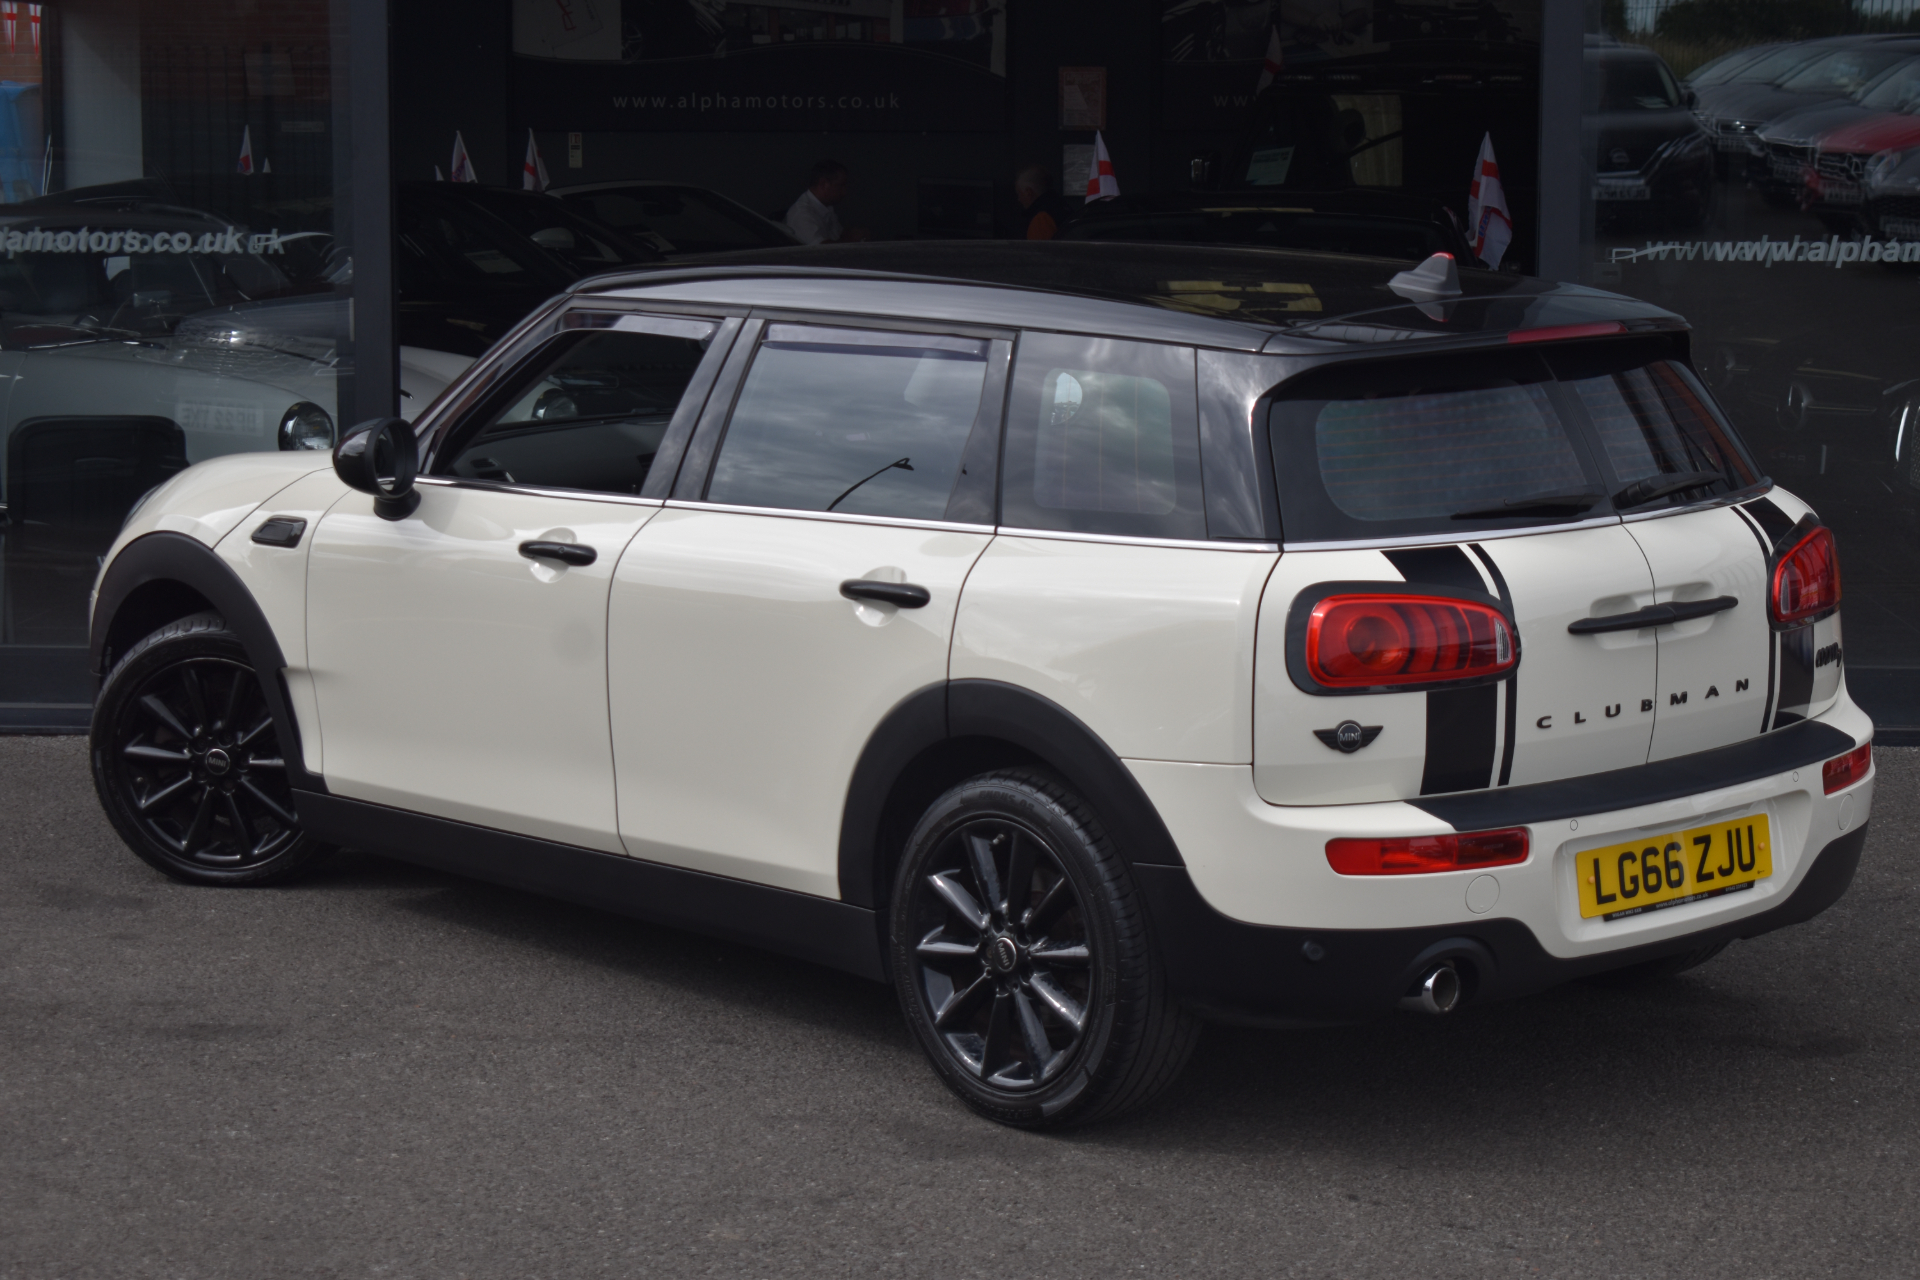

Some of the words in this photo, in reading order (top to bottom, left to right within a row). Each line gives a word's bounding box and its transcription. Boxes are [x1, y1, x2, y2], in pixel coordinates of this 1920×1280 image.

[612, 92, 900, 112] www.alphamotors.co.uk
[0, 226, 244, 253] amotors.co.uk
[1536, 678, 1749, 729] CLUBMAN
[1339, 732, 1361, 742] MINI
[208, 756, 227, 768] MINI
[1593, 841, 1685, 905] LG66
[1692, 825, 1756, 883] ZJU
[997, 942, 1010, 967] MINI
